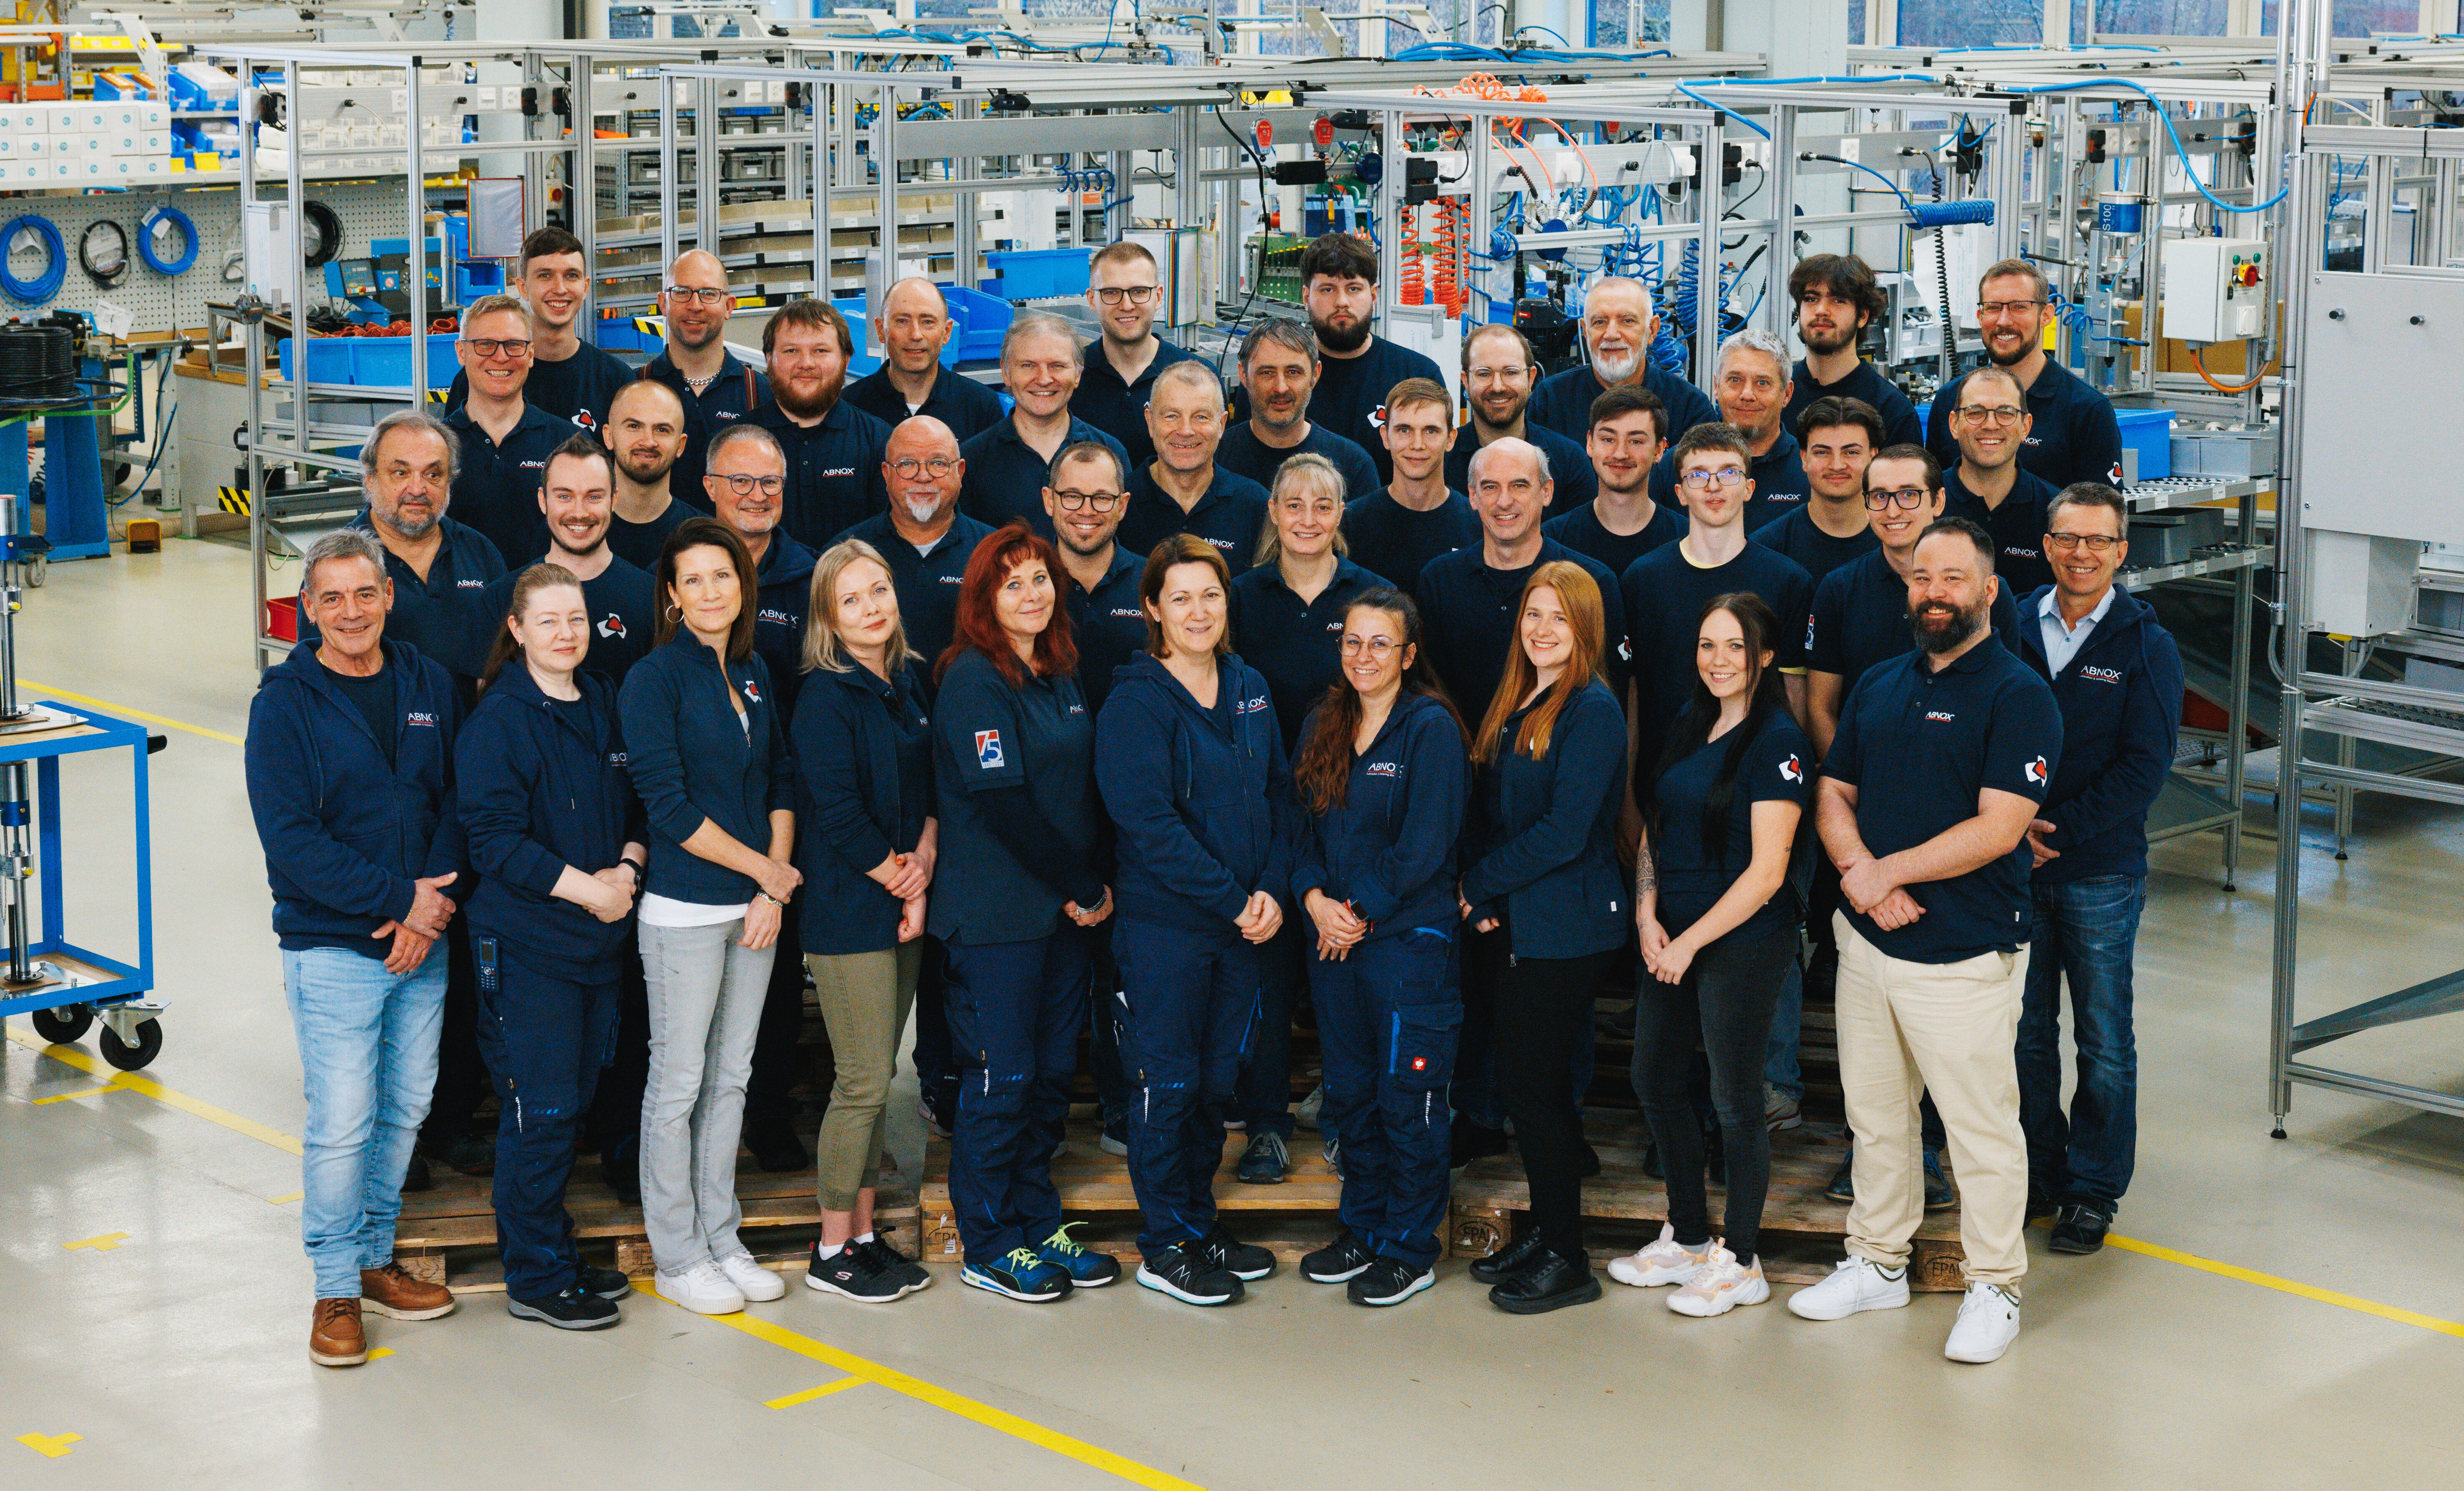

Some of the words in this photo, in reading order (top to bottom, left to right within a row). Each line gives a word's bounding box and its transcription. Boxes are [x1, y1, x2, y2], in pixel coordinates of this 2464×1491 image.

[2102, 204, 2112, 231] S100
[823, 468, 855, 476] ABNOX
[1204, 538, 1234, 548] ABNOX
[2005, 547, 2038, 557] ABNOX
[2081, 665, 2122, 680] ABNOX
[1925, 712, 1955, 721] ABNOX
[975, 729, 1003, 762] 75
